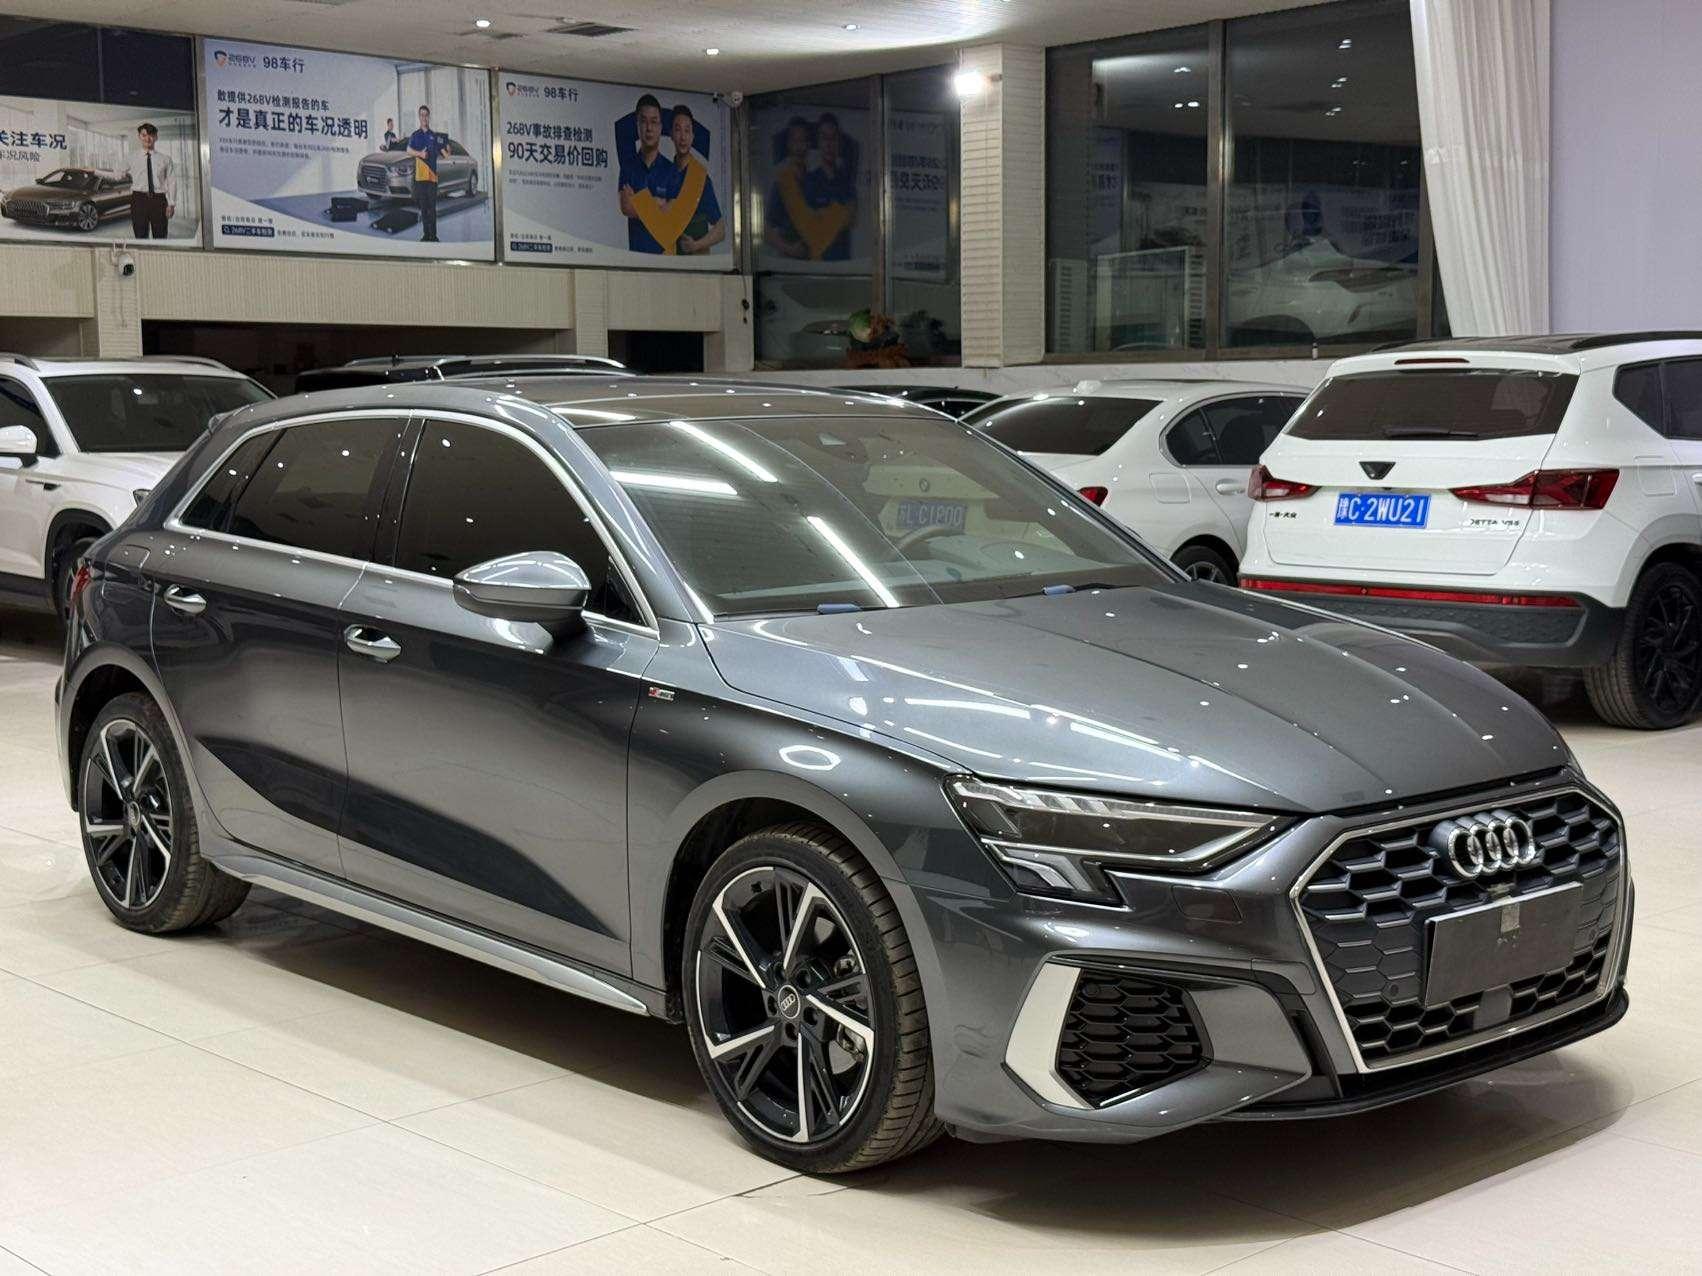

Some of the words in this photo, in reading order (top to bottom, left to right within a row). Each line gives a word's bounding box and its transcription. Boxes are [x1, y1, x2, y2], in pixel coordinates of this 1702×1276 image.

[263, 56, 305, 73] 98车行
[544, 86, 579, 102] 98车行
[218, 107, 369, 139] 才是真正的车况透明
[506, 122, 593, 143] 268V事故排查检测
[507, 142, 609, 168] 90天交易价回购
